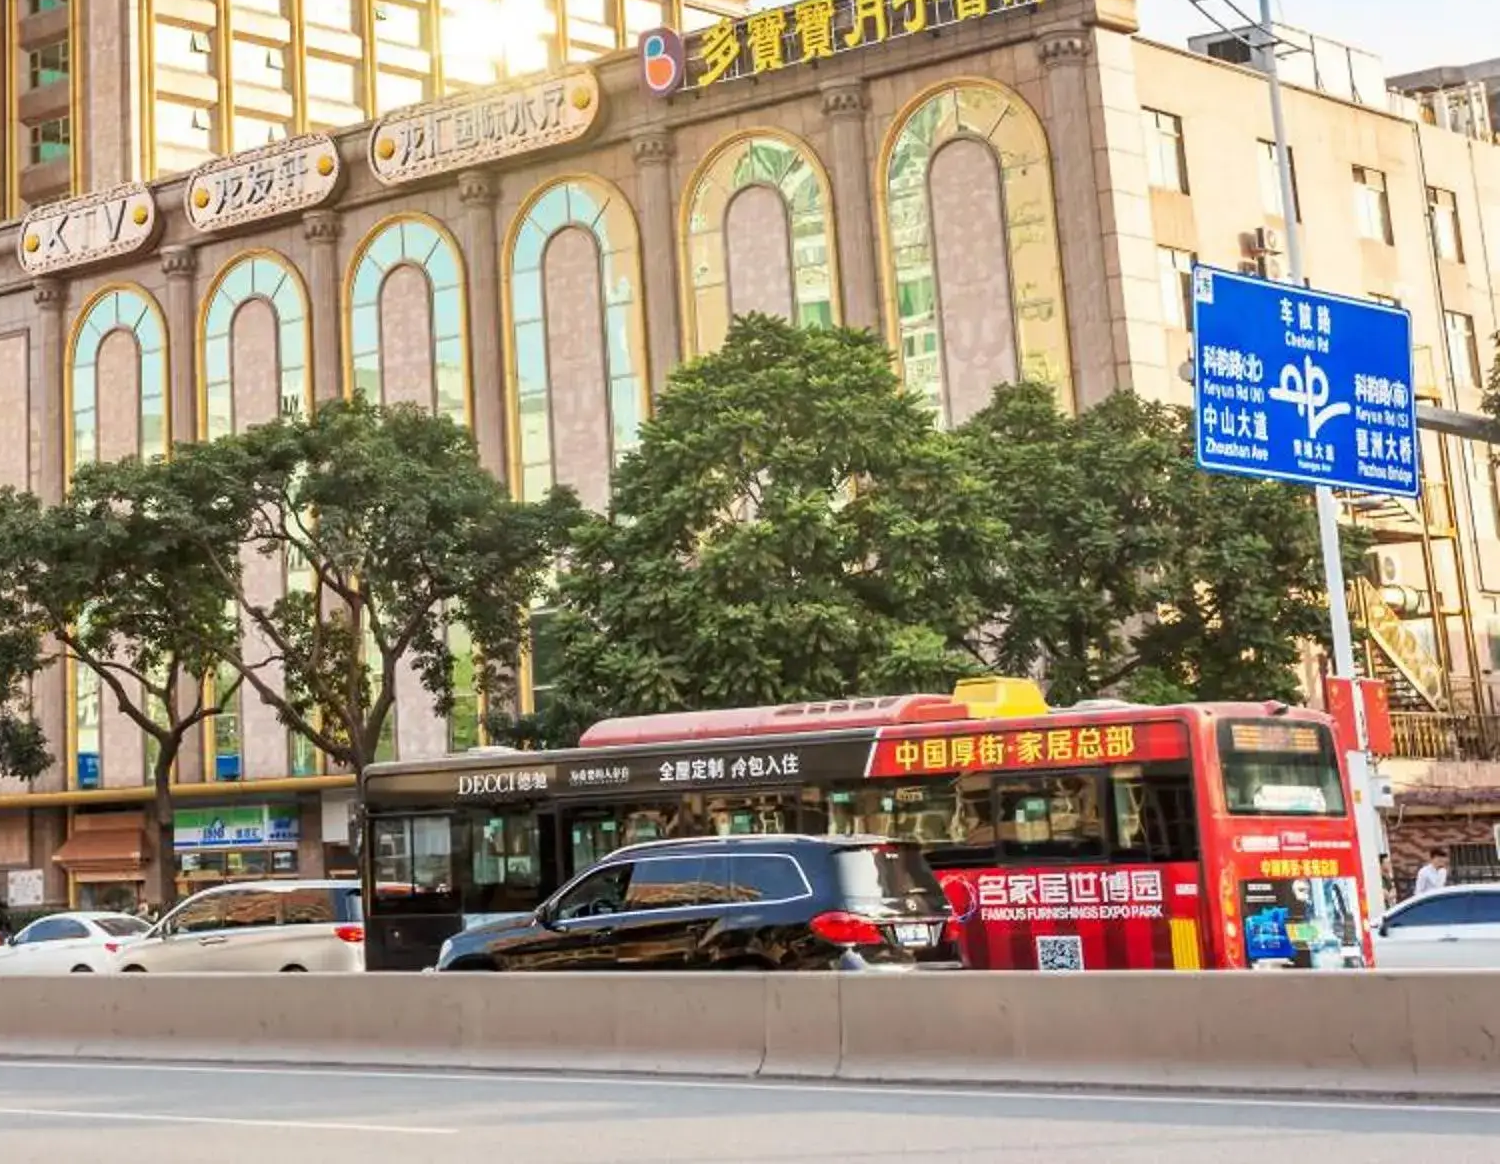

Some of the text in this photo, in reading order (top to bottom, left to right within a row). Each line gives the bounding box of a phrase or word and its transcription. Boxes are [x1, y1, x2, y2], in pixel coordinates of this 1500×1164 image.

[40, 200, 127, 255] KTV
[1204, 402, 1268, 441] 中山大道
[458, 774, 515, 795] DECCI
[978, 870, 1163, 905] 名家居世博园
[981, 904, 1164, 922] FAMOUS FURNISHINGS EXPO PARK
